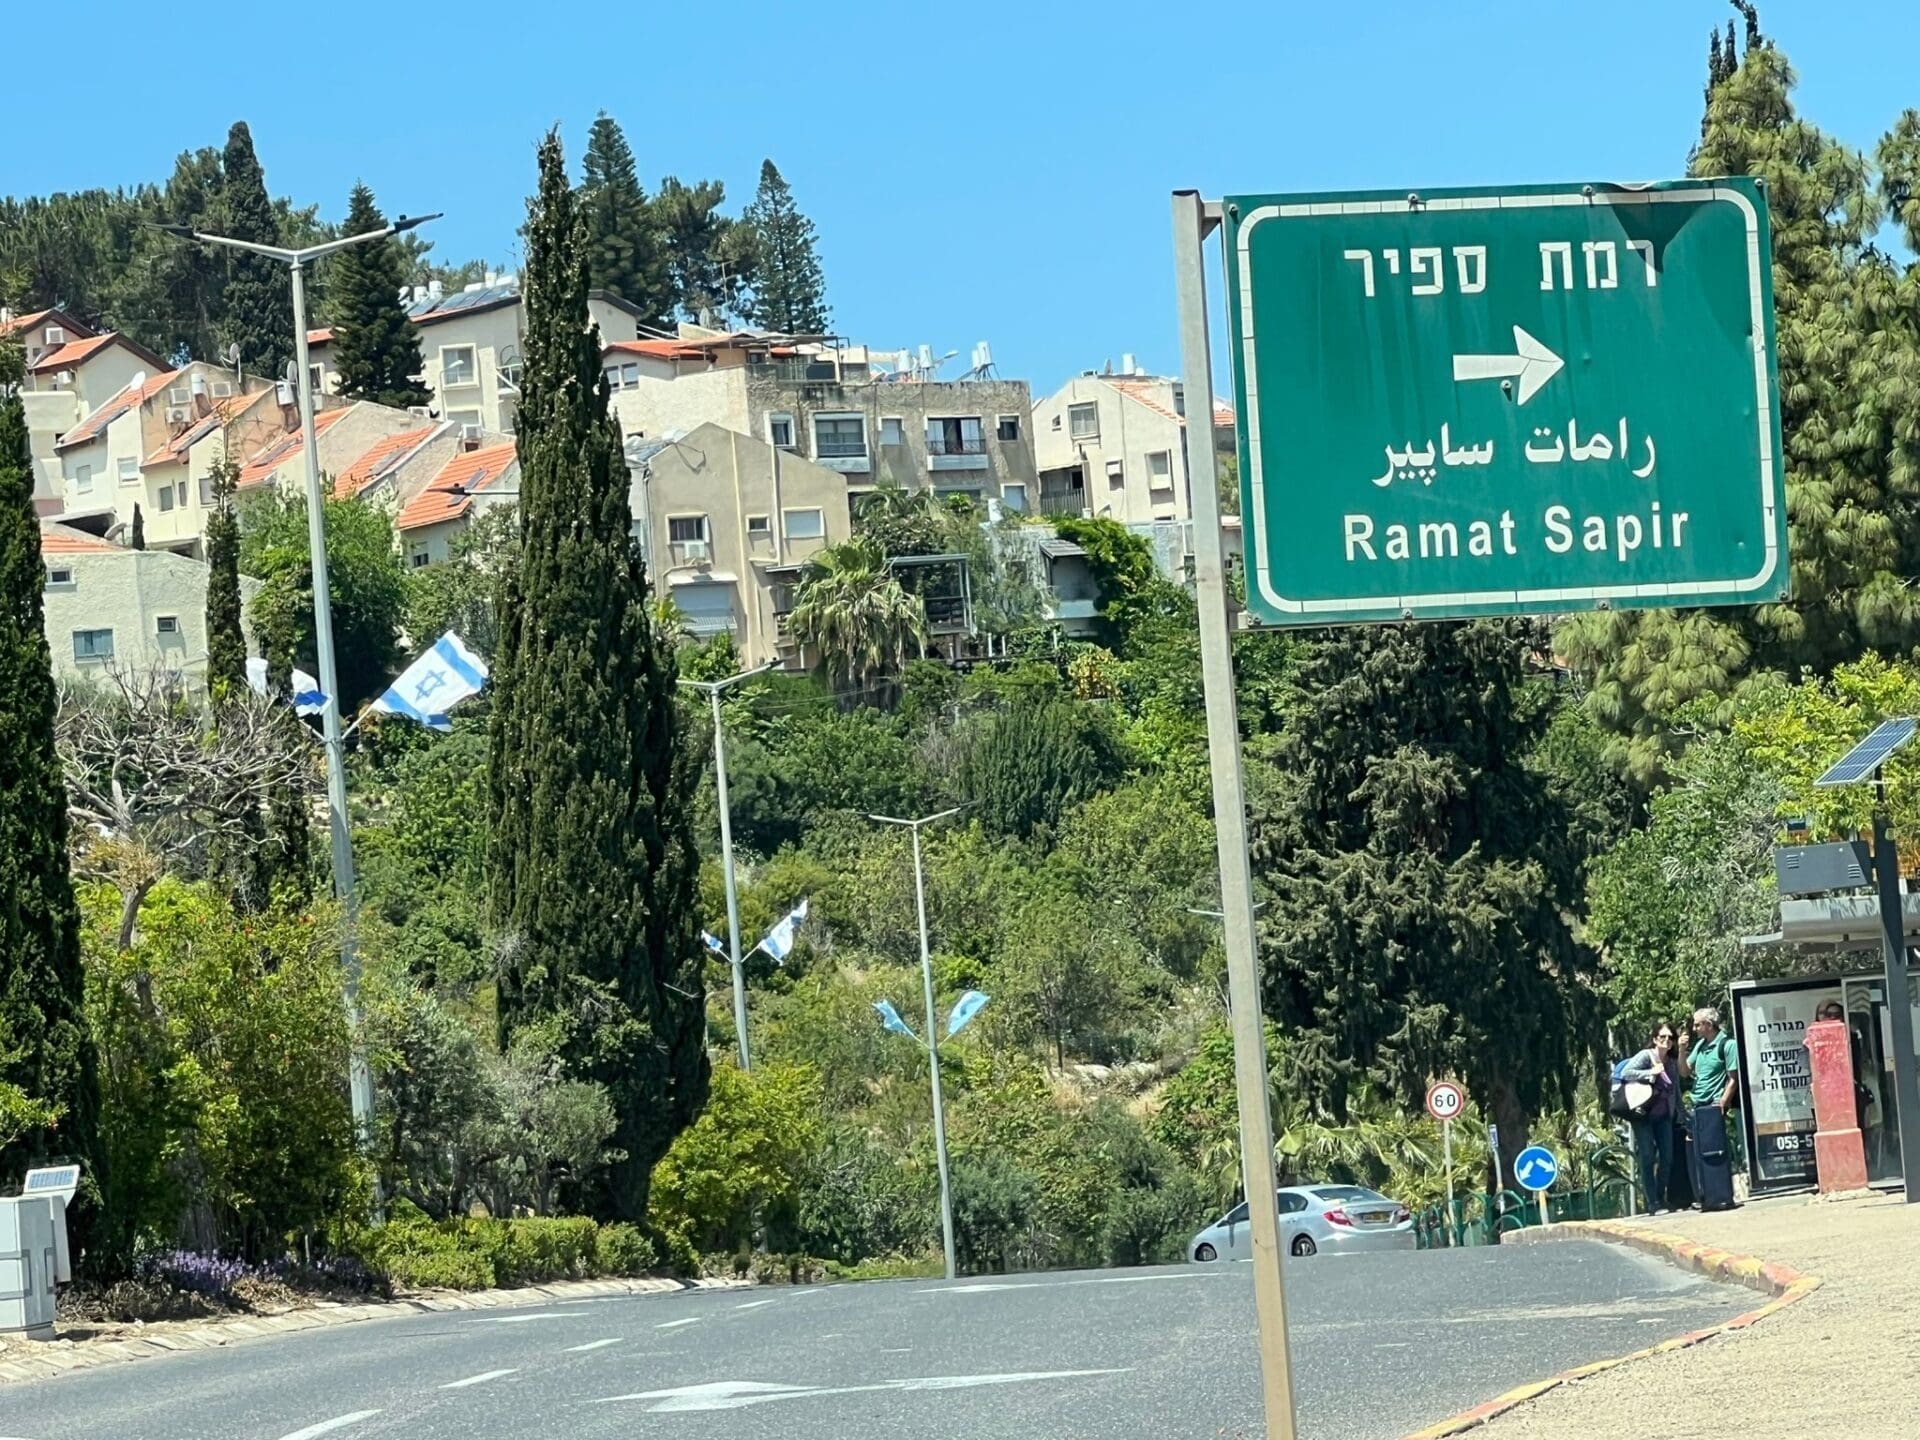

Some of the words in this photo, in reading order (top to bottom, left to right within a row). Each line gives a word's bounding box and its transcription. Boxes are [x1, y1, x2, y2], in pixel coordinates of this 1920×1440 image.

[1344, 244, 1487, 298] ספיר
[1539, 239, 1658, 291] רמת
[1524, 416, 1657, 478] رامات
[1344, 509, 1518, 562] Ramat
[1544, 501, 1690, 563] Sapir
[1758, 1020, 1805, 1034] מגורים
[1434, 1094, 1456, 1108] 60
